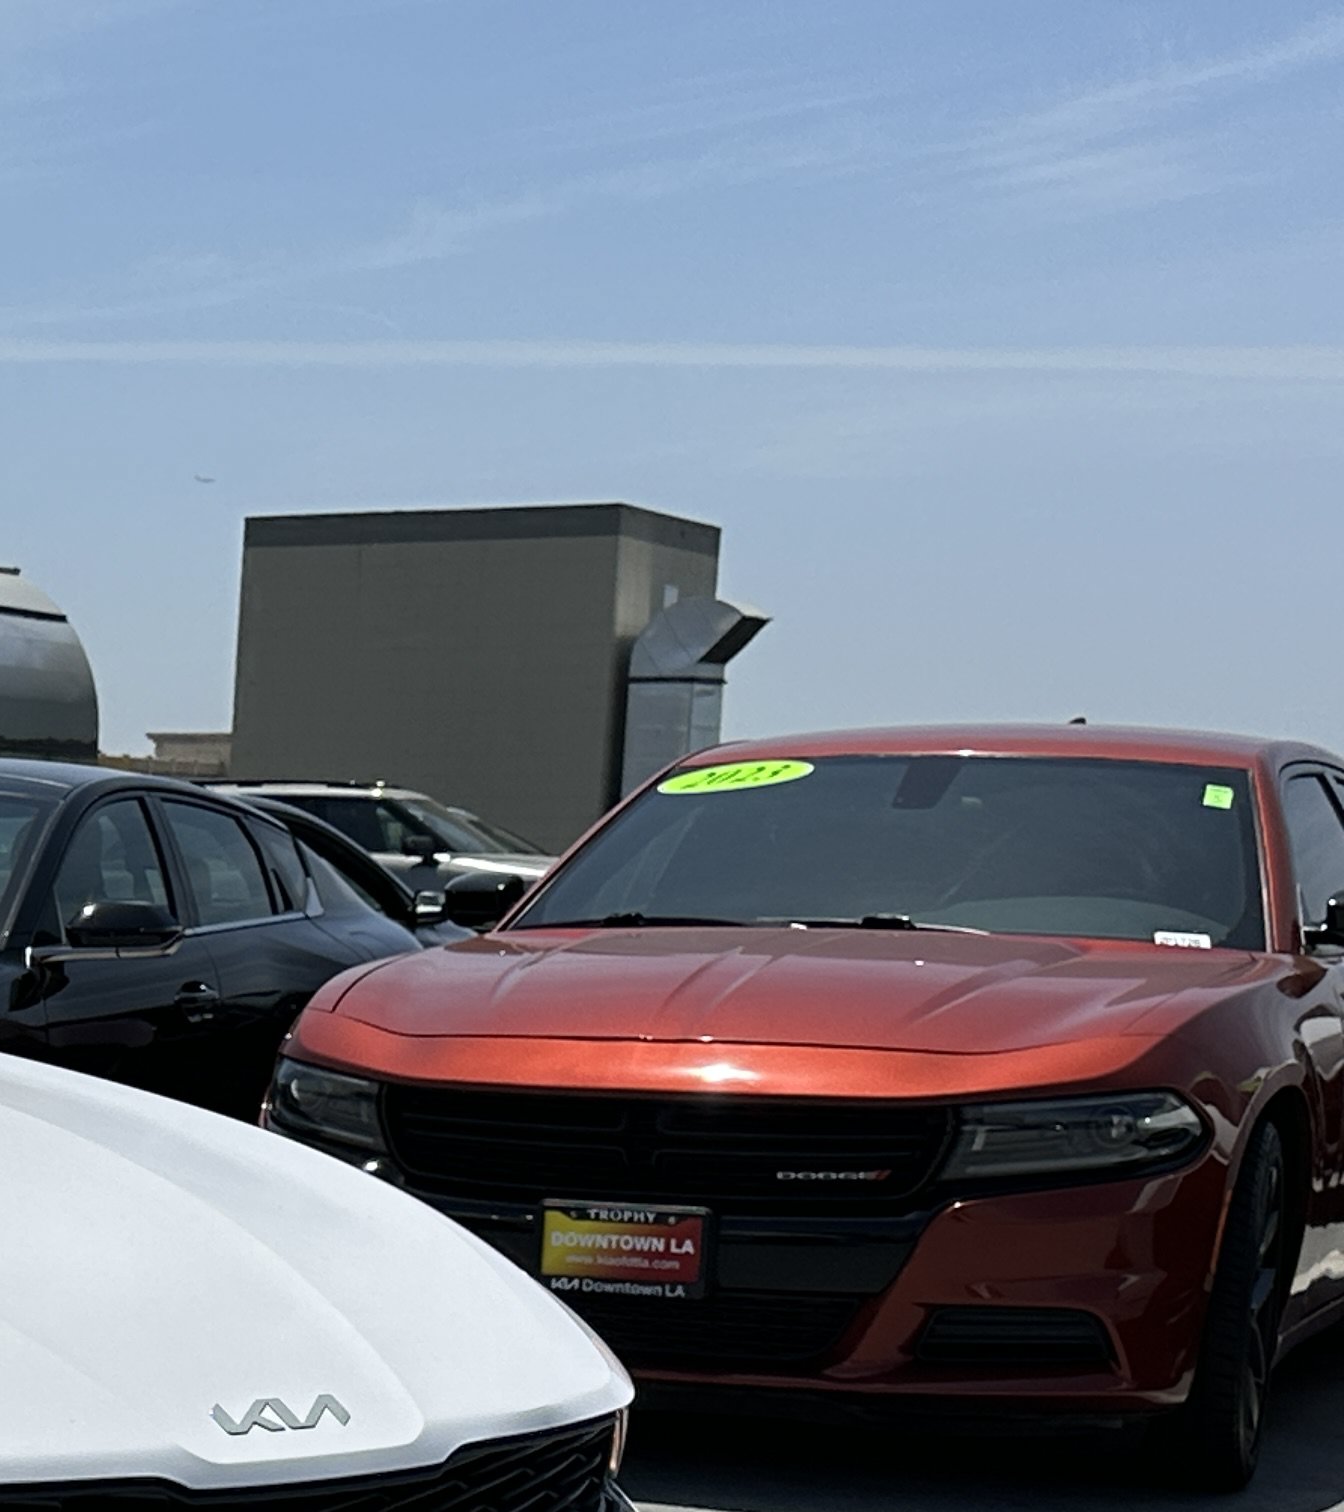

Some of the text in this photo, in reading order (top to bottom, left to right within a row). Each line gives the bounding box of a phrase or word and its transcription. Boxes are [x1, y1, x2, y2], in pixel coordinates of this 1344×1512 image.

[587, 1209, 656, 1223] TROPHY
[551, 1231, 695, 1254] DOWNTOWN LA
[582, 1279, 662, 1297] Downtown
[665, 1284, 686, 1298] LA
[211, 1394, 351, 1435] KIA
